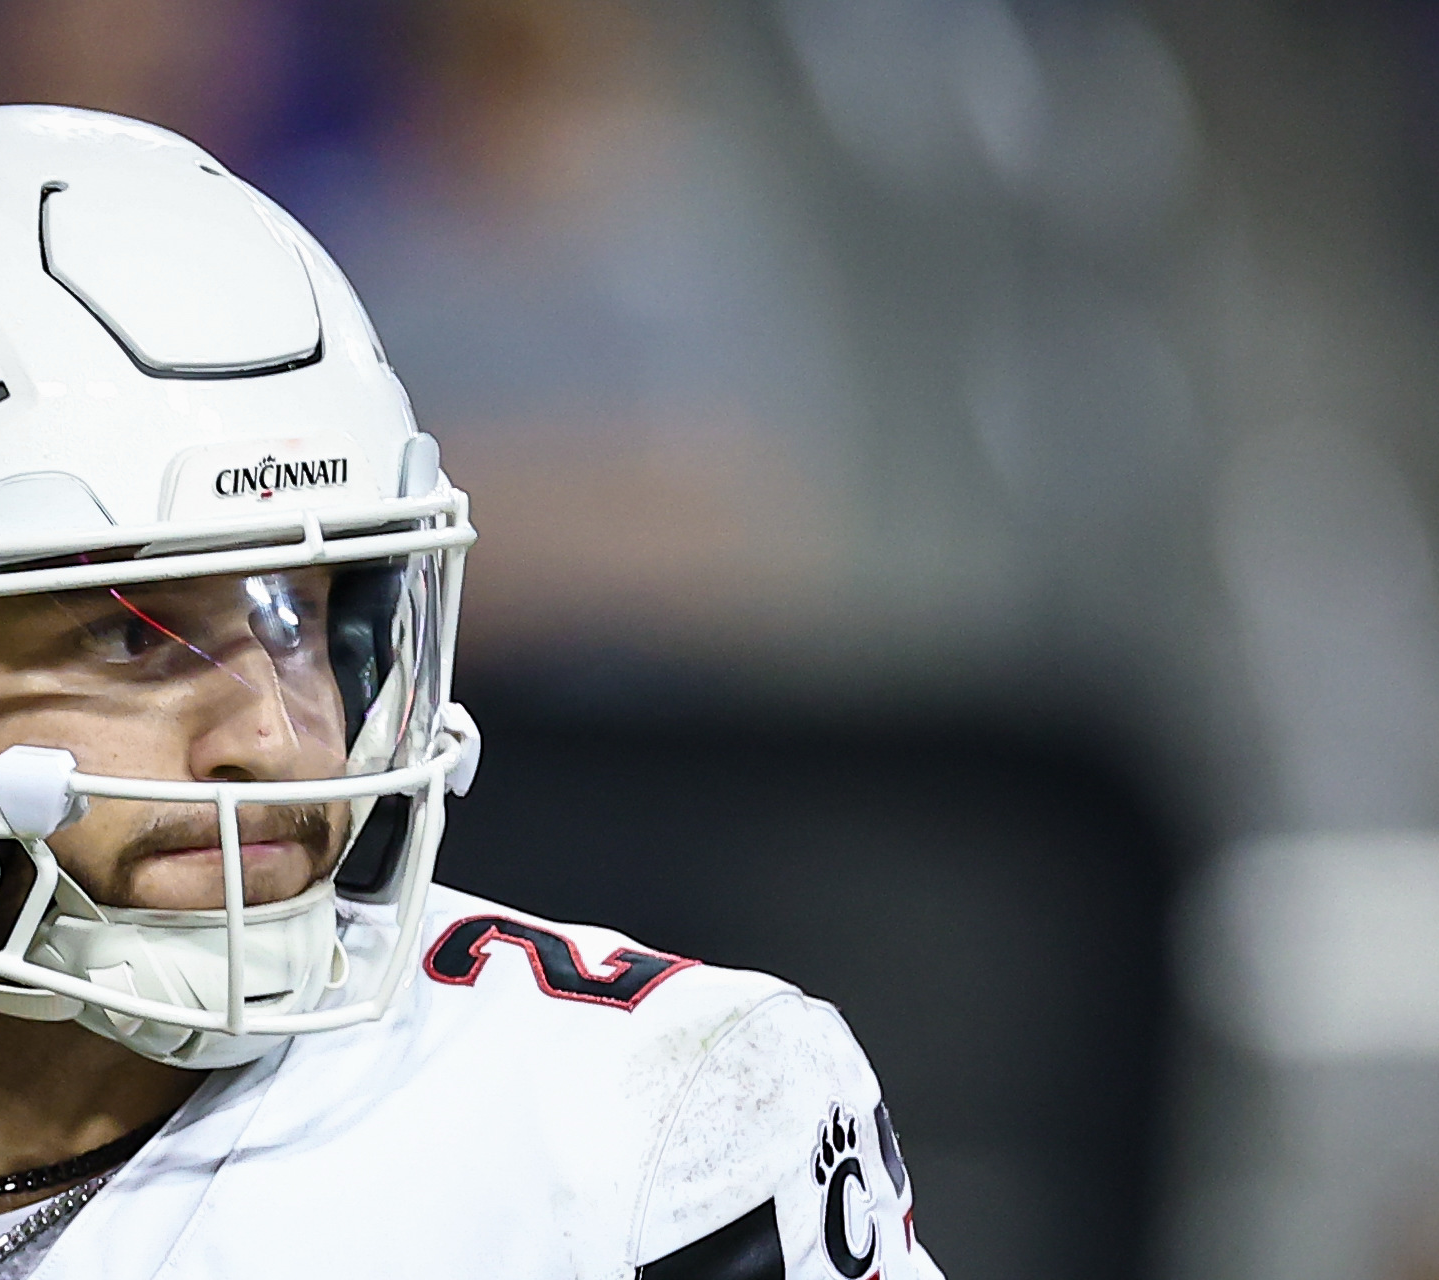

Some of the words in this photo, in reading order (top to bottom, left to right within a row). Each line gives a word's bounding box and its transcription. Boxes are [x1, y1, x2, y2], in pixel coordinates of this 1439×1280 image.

[215, 457, 347, 496] CINCINNATI
[423, 914, 704, 1012] 2
[823, 1157, 876, 1280] C
